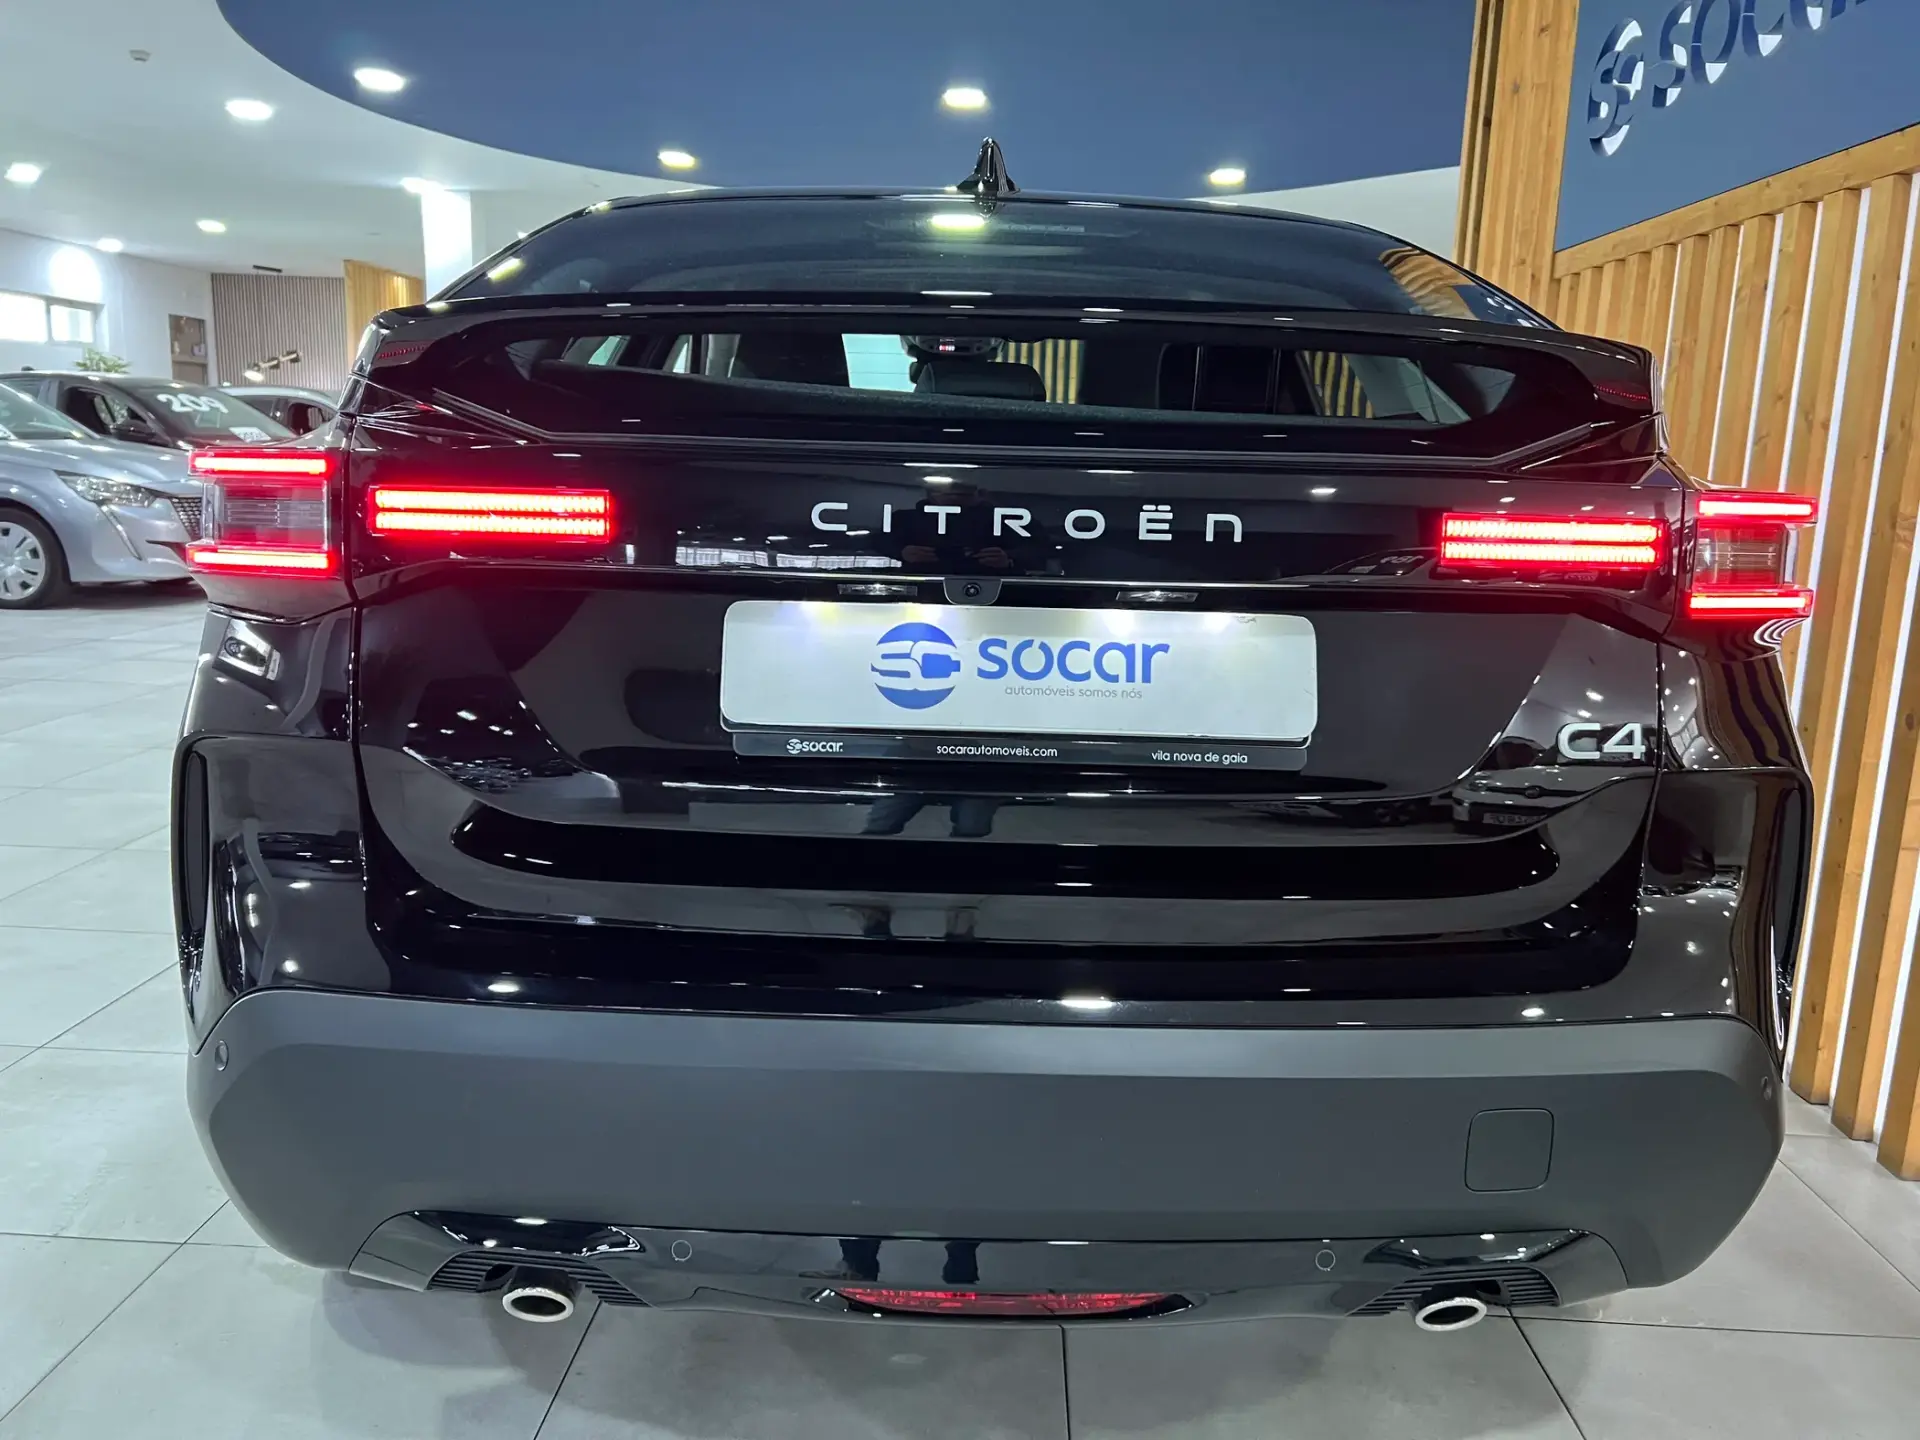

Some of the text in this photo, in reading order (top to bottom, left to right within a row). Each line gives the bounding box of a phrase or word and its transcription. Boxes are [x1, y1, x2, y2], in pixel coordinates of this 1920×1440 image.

[977, 638, 1170, 684] socar
[1005, 685, 1143, 699] automóveis somos nós
[1558, 722, 1646, 760] C4
[936, 743, 1058, 757] socarautomoveis.com
[1151, 750, 1248, 765] vila nova de gaia
